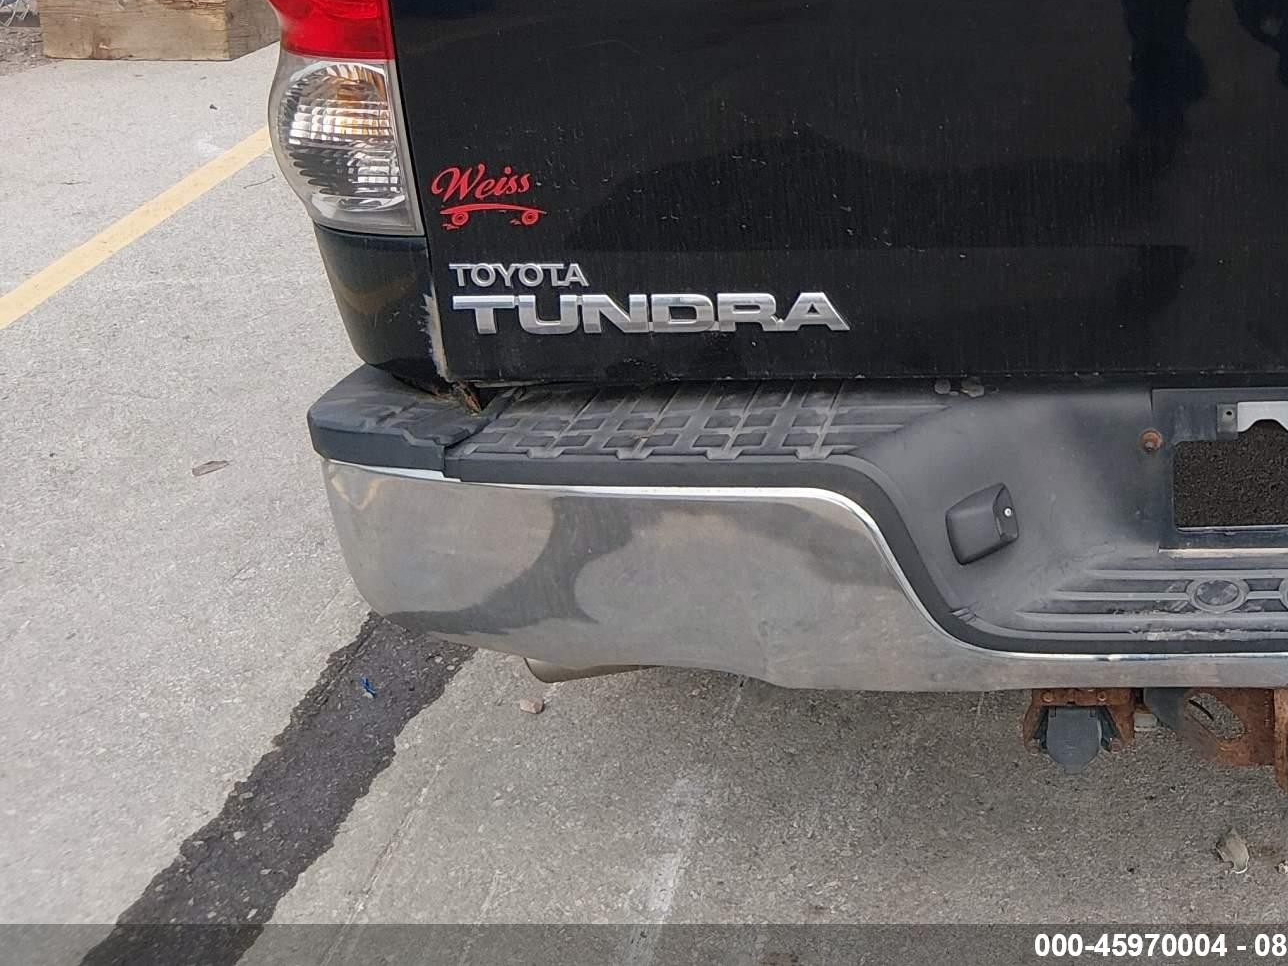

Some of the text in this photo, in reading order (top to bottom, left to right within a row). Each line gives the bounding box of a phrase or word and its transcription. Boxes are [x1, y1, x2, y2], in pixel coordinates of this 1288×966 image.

[431, 163, 531, 202] Weiss
[449, 263, 589, 287] TOYOTA
[452, 292, 851, 335] TUNDRA
